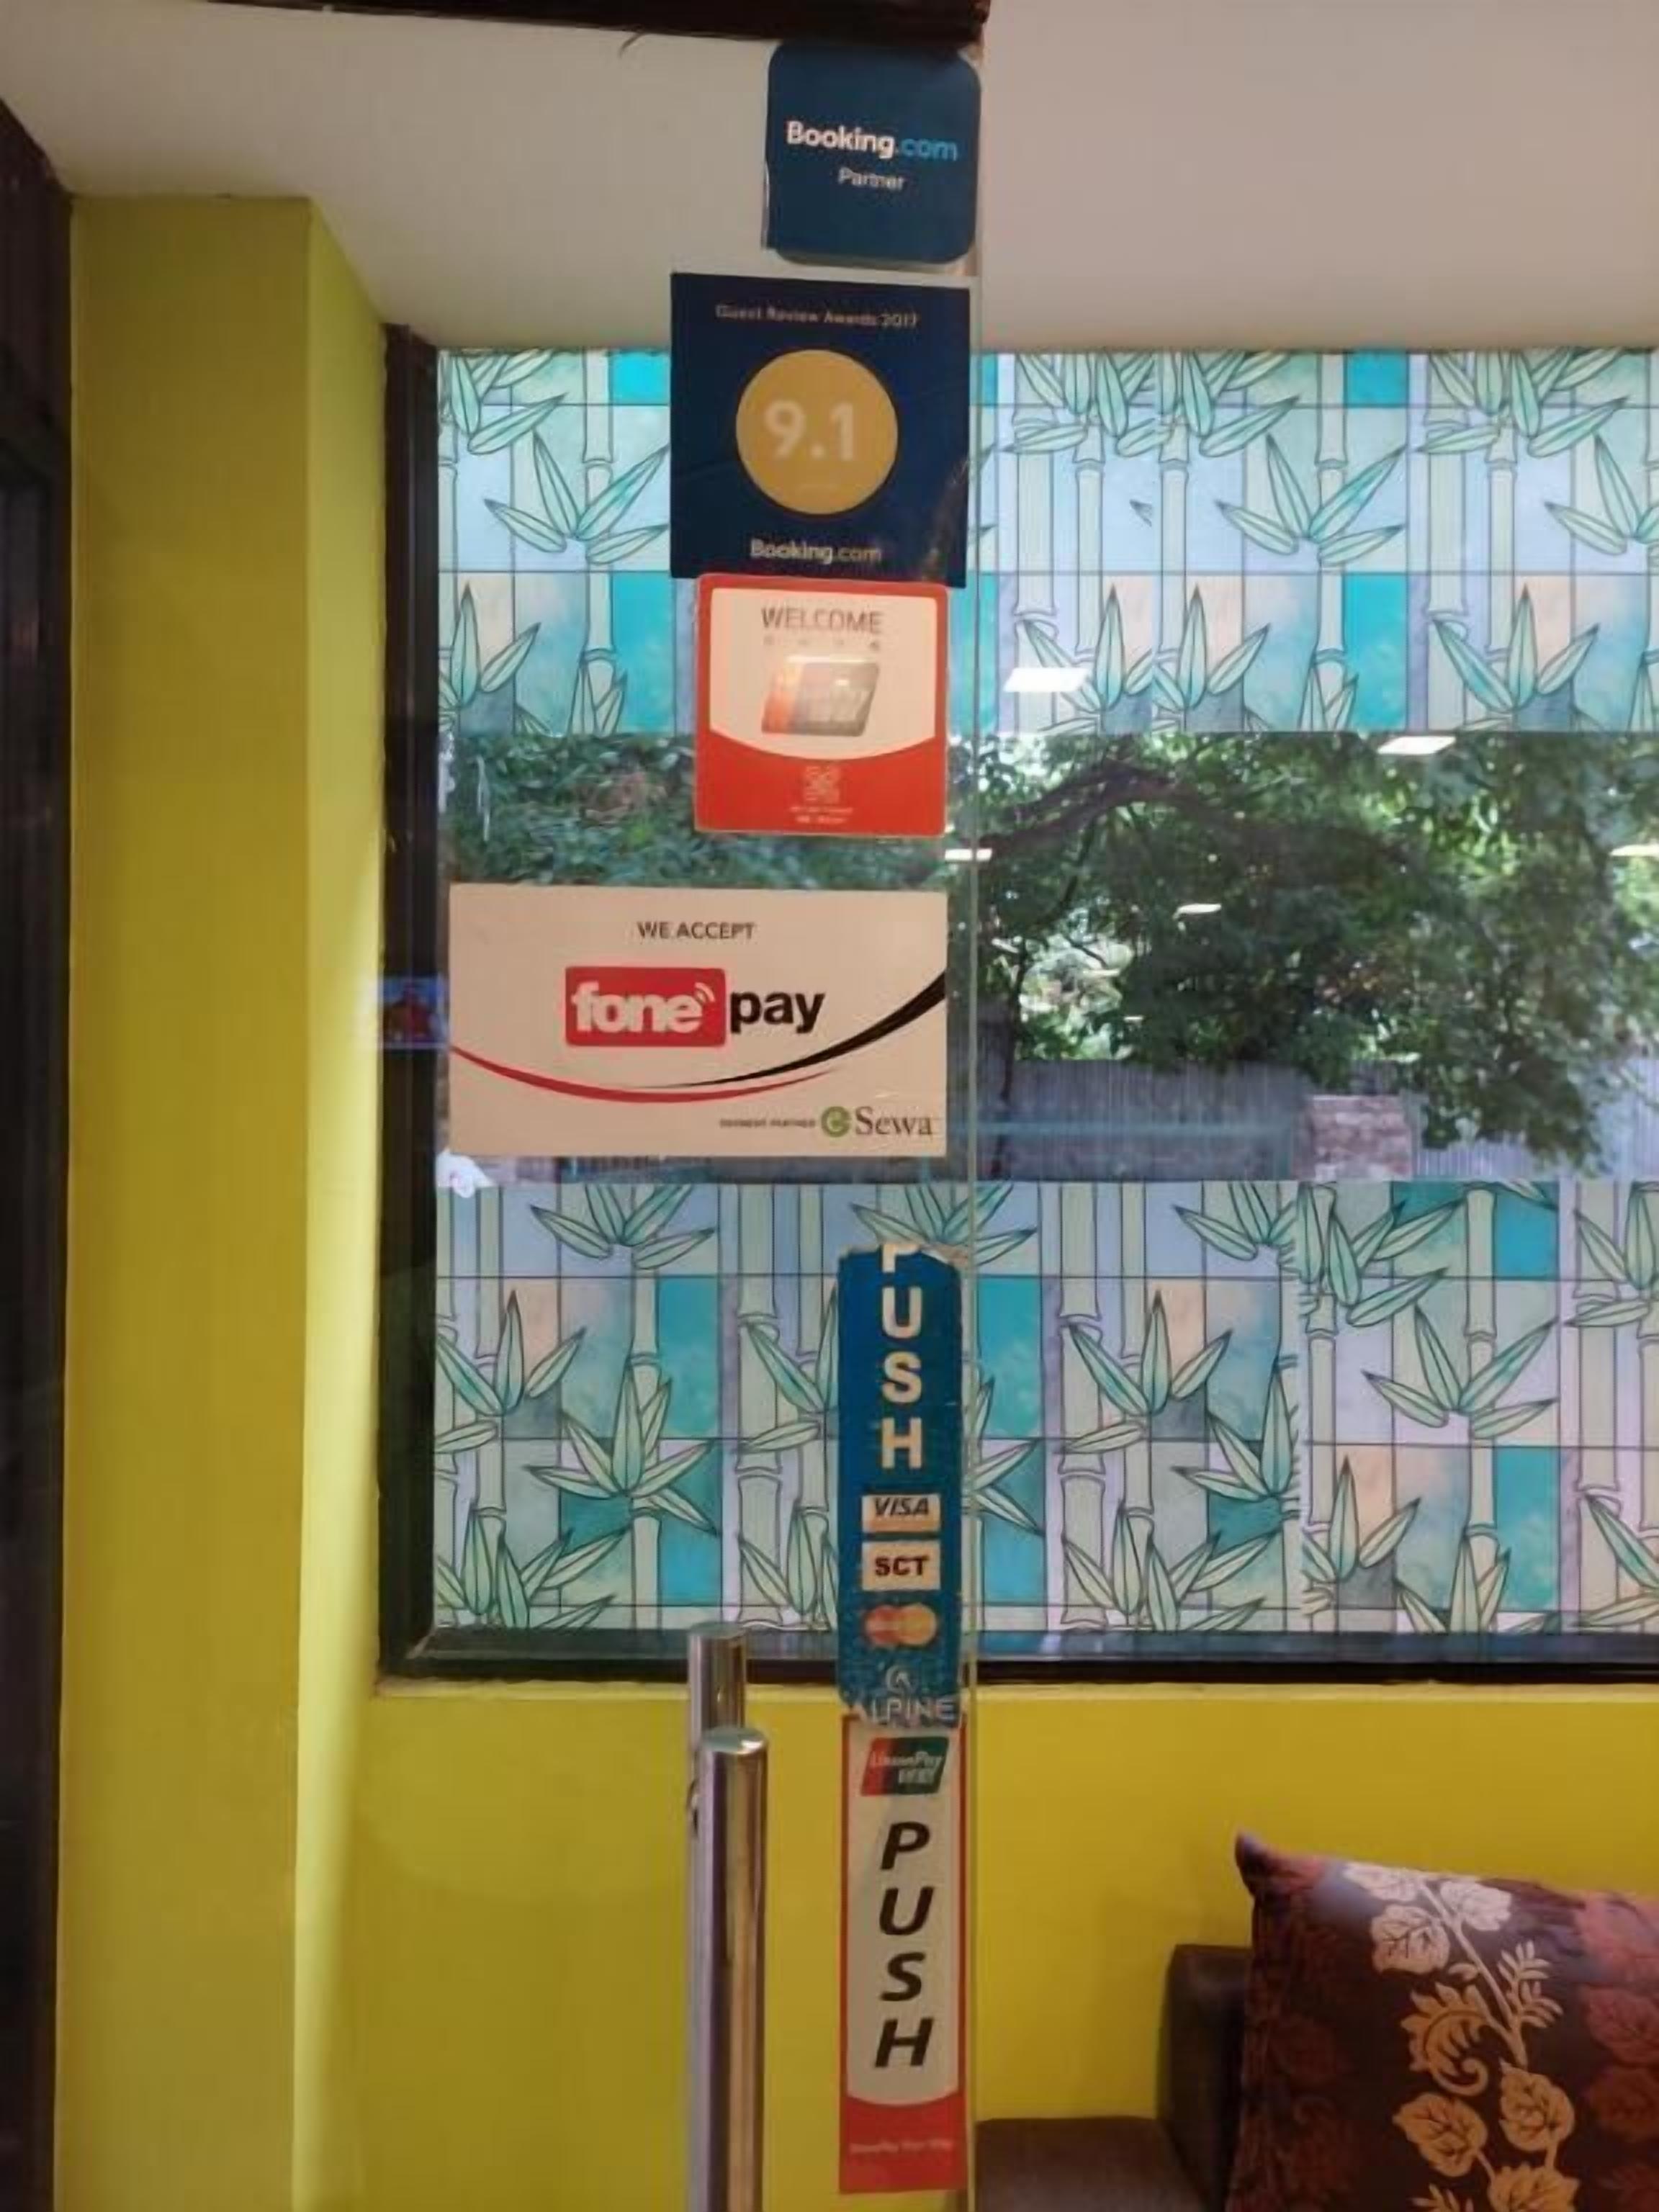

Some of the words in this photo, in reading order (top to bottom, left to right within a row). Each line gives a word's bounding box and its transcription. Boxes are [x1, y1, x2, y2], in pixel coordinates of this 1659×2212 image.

[786, 120, 958, 161] Booking.com
[837, 166, 905, 191] Partner
[716, 304, 761, 320] Guest
[766, 306, 818, 323] Review
[824, 309, 876, 326] Awards
[763, 400, 853, 461] 9.1
[750, 538, 883, 565] Booking.com
[761, 607, 883, 634] WELCOME
[637, 921, 670, 940] WE
[677, 921, 756, 940] ACCEPT
[571, 979, 703, 1034] fone
[729, 990, 826, 1033] pay
[874, 1496, 930, 1516] VISA
[875, 1555, 930, 1577] SCT
[875, 1821, 935, 2068] PUSH
